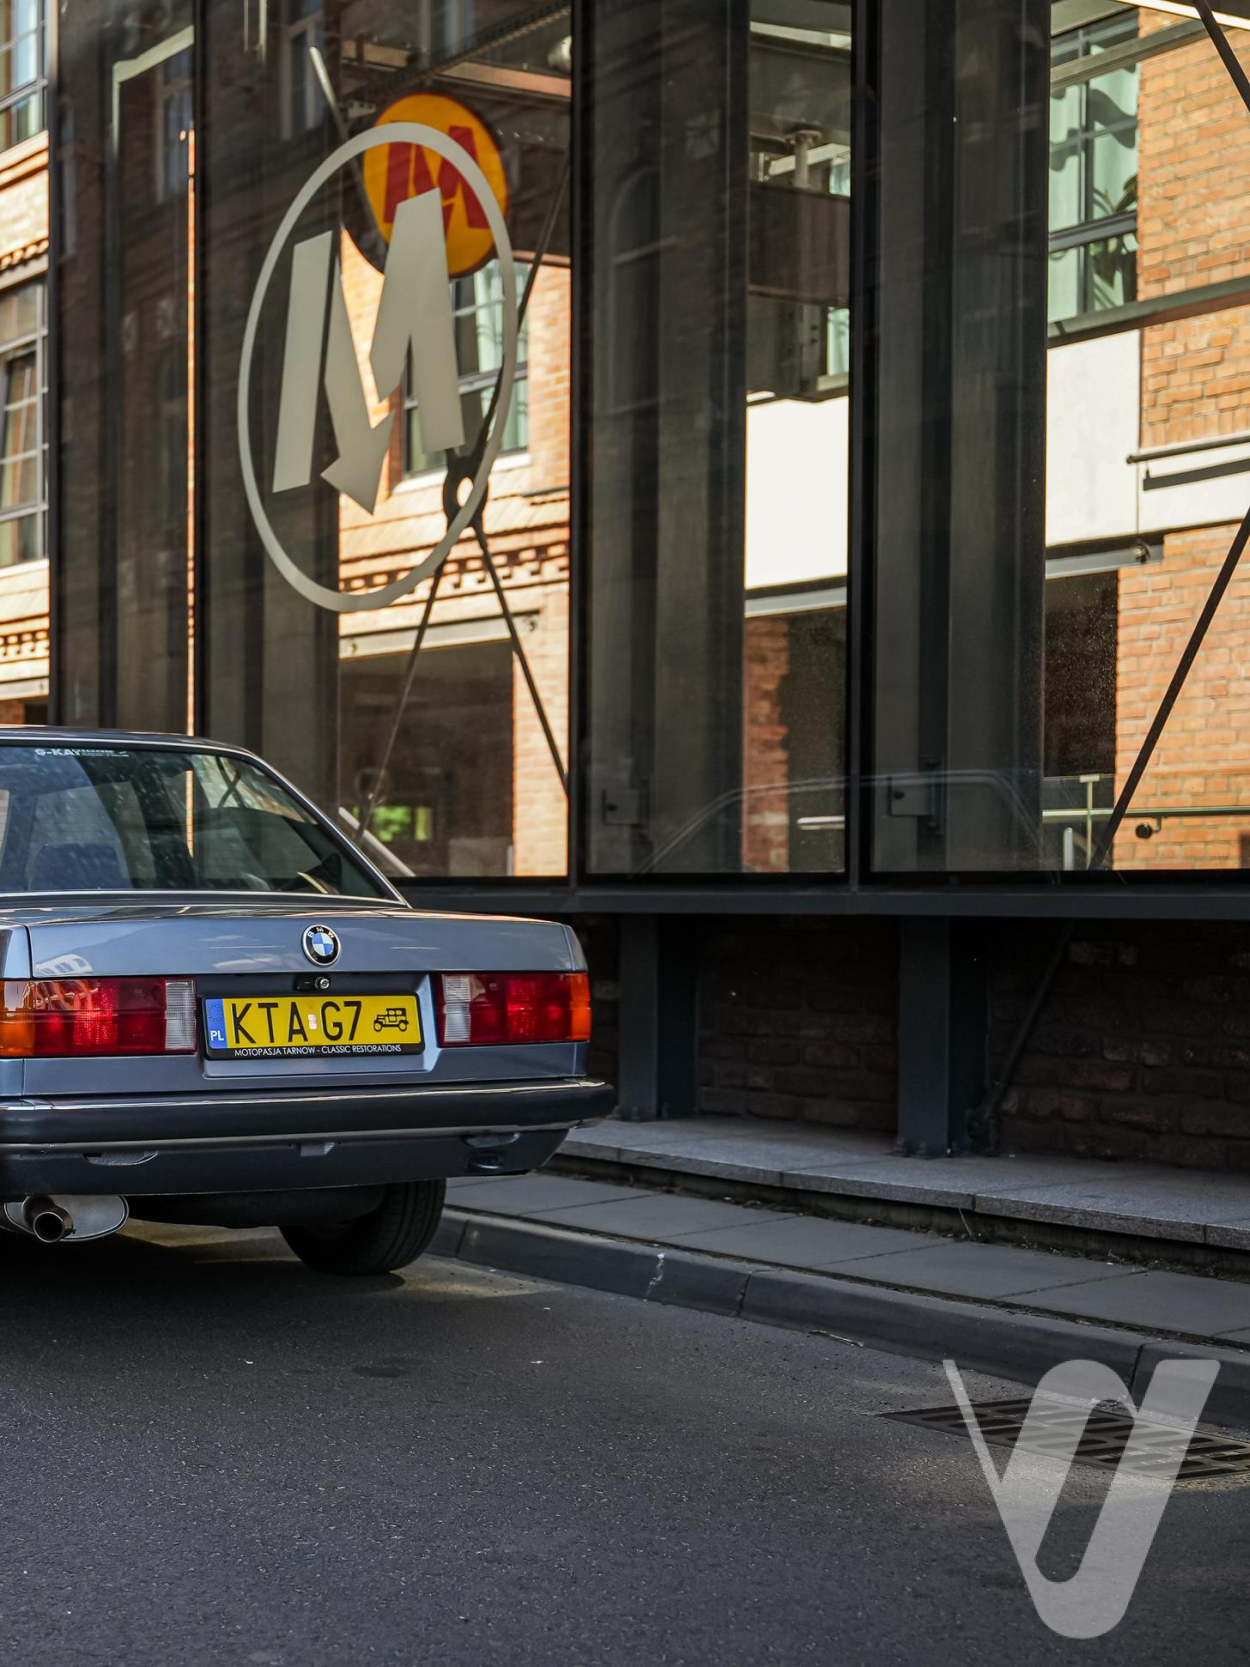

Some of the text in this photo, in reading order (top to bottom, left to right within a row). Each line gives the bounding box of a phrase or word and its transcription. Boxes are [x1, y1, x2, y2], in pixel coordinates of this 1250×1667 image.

[307, 926, 335, 938] BMW
[231, 1000, 362, 1045] KTA G7
[210, 1030, 225, 1042] PL
[234, 1047, 282, 1057] MOTOPASJA
[321, 1045, 351, 1054] CLASSIC
[352, 1044, 402, 1053] RESTORATIONS
